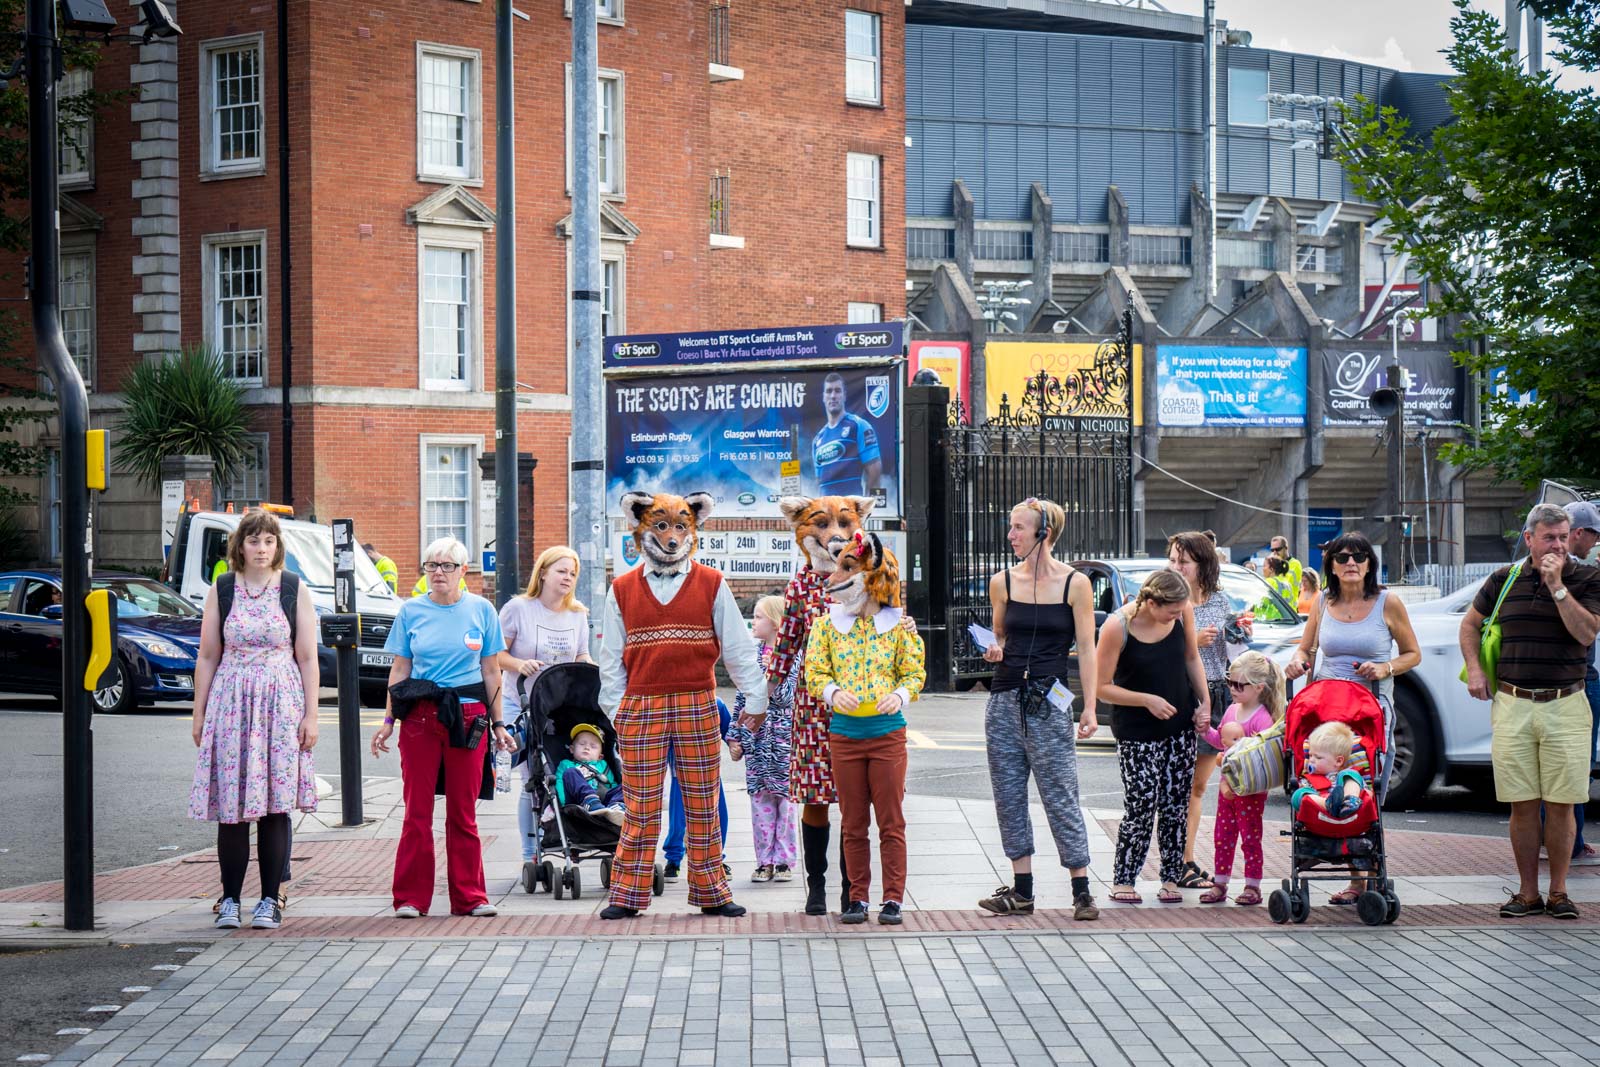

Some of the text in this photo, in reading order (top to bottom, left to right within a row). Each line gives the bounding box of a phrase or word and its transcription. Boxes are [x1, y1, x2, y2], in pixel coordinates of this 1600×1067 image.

[679, 331, 814, 347] Welcome to BT Sport Cardiff Arms Park
[842, 333, 887, 346] BT Sport
[619, 344, 656, 357] BT Sport
[704, 349, 720, 359] Barc
[721, 349, 728, 358] Yr
[730, 347, 751, 357] Arfau
[751, 346, 785, 357] Caerdydd
[786, 345, 796, 354] BT
[797, 344, 818, 356] Sport
[1172, 356, 1179, 366] If
[1180, 358, 1196, 368] you
[1197, 358, 1218, 367] were
[1220, 356, 1251, 368] looking
[1253, 356, 1265, 366] for
[1273, 357, 1291, 368] sign
[1350, 360, 1360, 368] The
[1175, 369, 1193, 378] that
[1194, 370, 1210, 380] you
[1211, 369, 1244, 379] needed
[1245, 371, 1251, 379] a
[616, 382, 807, 413] THE SCOTS ARE COMING
[1208, 390, 1259, 403] This is it!
[1420, 382, 1455, 402] lounge
[1162, 398, 1200, 407] COASTAL
[1332, 400, 1364, 409] Cardiff's
[1419, 400, 1439, 410] night
[1440, 400, 1452, 409] out
[1162, 406, 1200, 415] COTTAGES
[1045, 418, 1129, 433] GWYN NICHOLLS
[631, 432, 692, 443] Edinburgh Rugby
[723, 429, 790, 440] Glasgow Warriors
[625, 455, 637, 464] Sat
[720, 452, 729, 460] Fri
[710, 538, 723, 549] Sat
[737, 536, 755, 548] 24th
[731, 560, 780, 574] Llandovery
[366, 655, 381, 664] CV15
